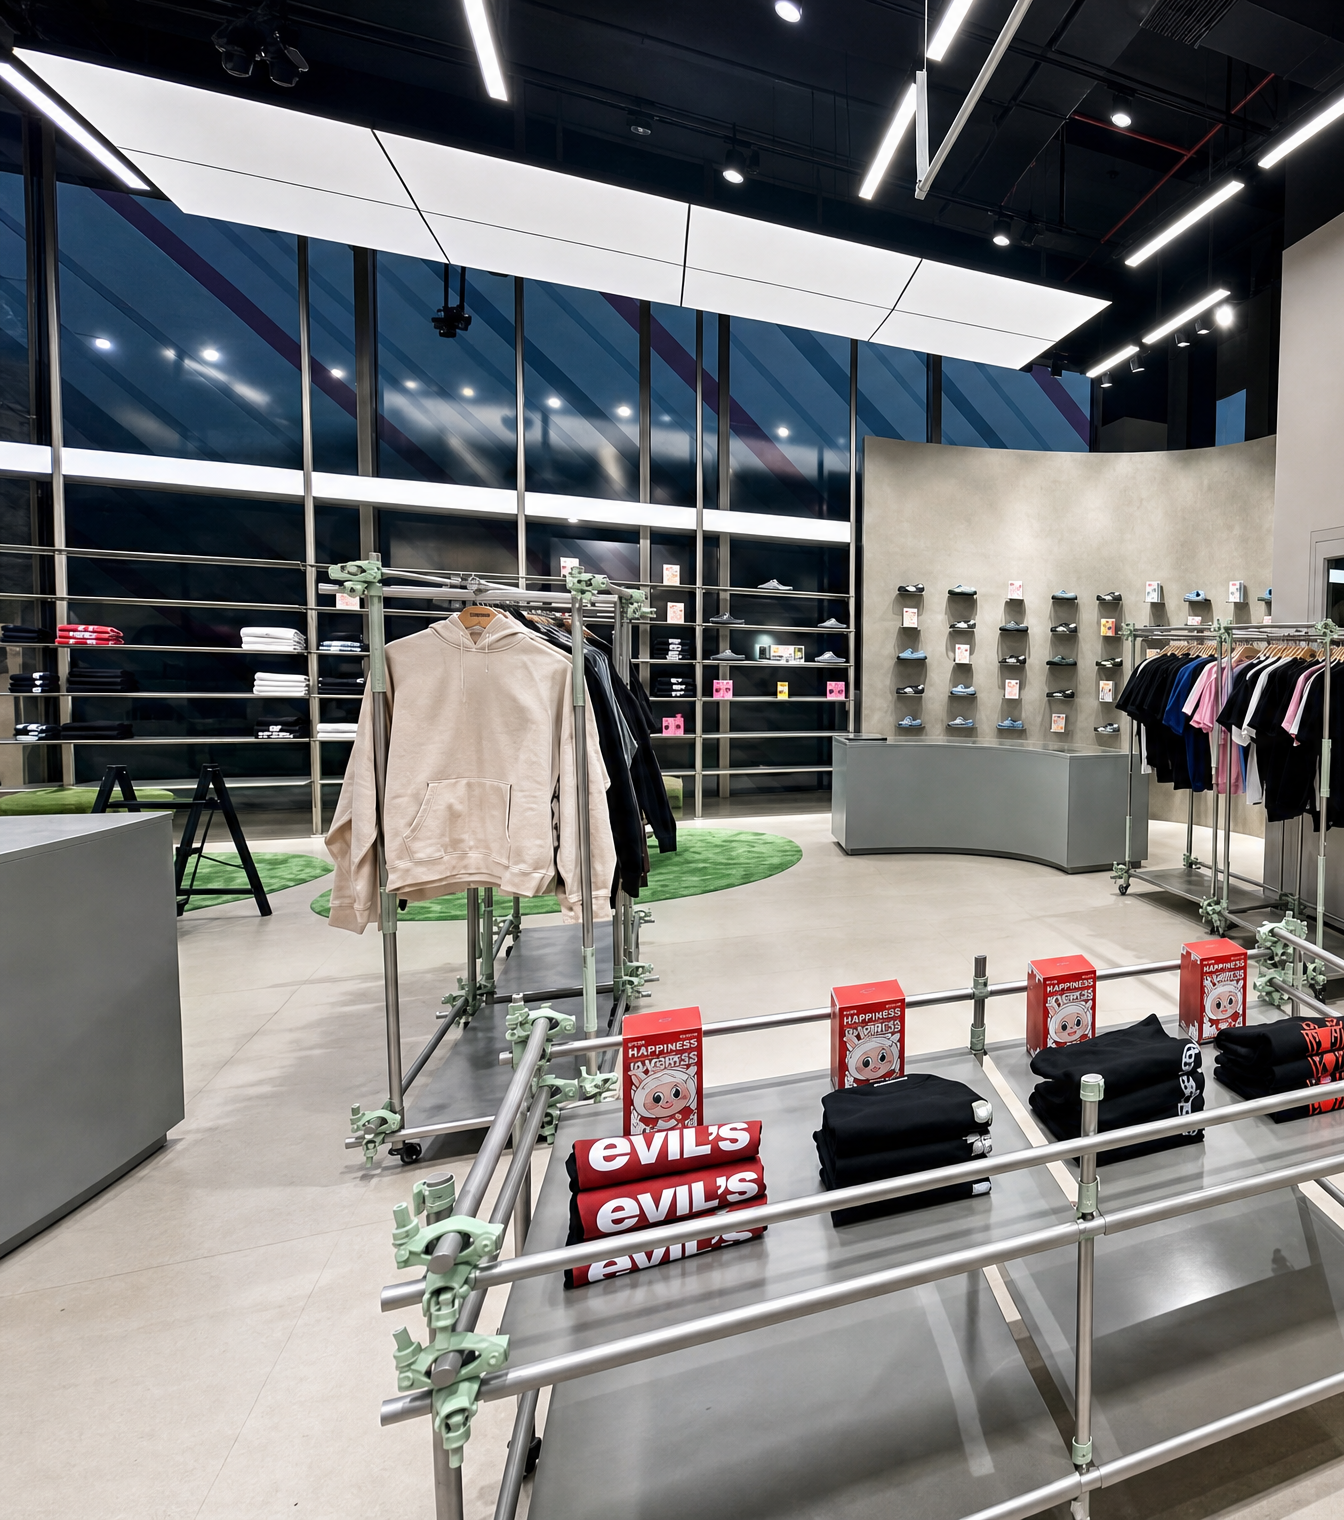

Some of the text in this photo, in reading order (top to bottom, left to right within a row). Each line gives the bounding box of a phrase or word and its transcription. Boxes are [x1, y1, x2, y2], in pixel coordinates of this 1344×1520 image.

[1203, 960, 1245, 973] HAPPINESS
[1046, 979, 1094, 994] HAPPINESS
[843, 1008, 901, 1026] HAPPINESS
[628, 1038, 698, 1058] HAPPINESS
